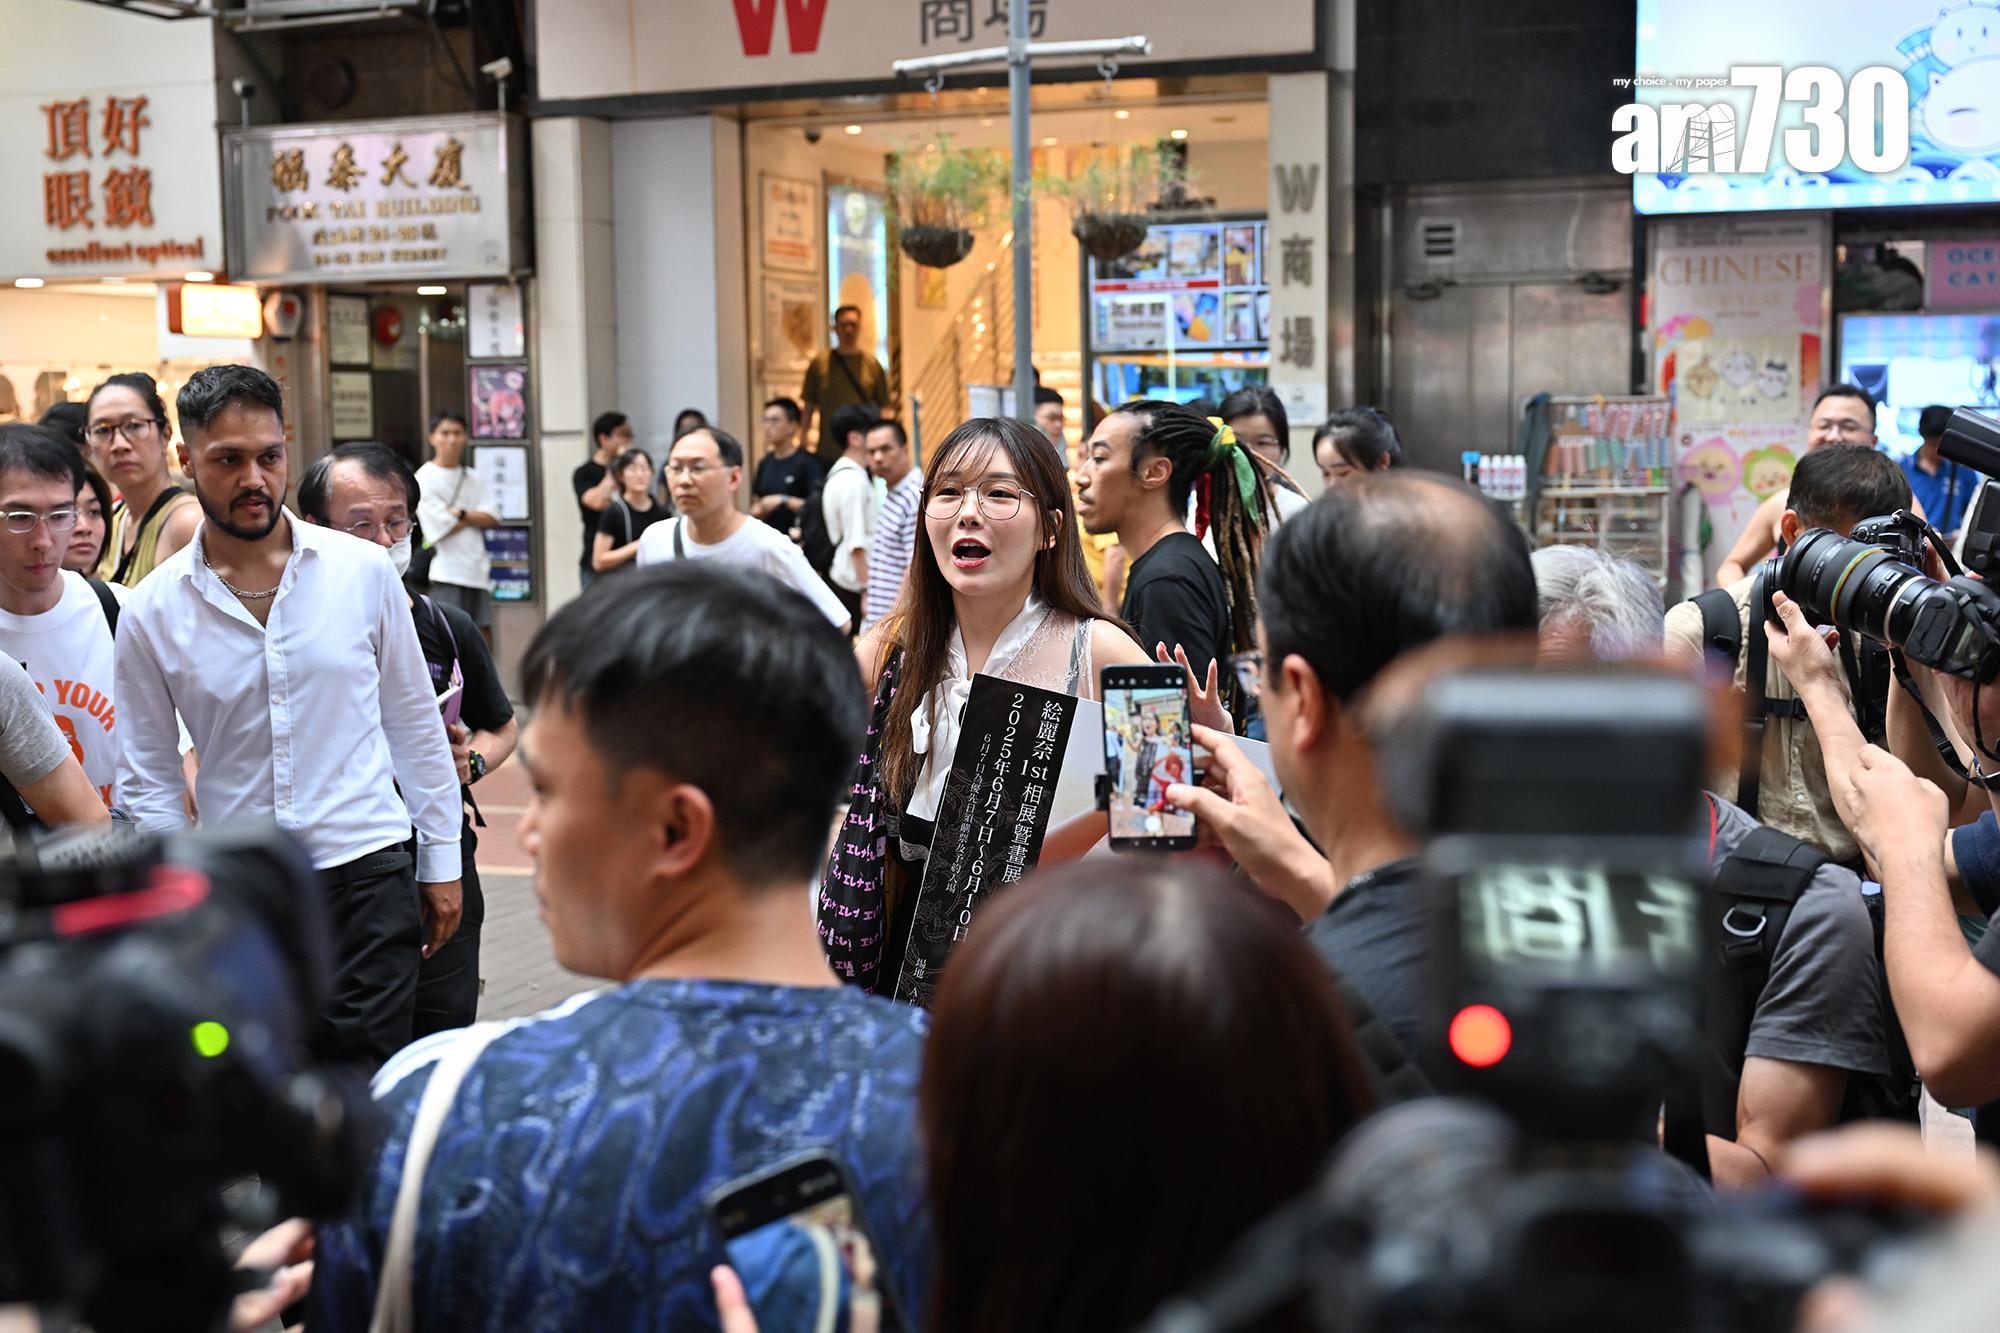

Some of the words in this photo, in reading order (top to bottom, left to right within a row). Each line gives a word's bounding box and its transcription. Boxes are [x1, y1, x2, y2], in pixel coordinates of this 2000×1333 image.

[732, 0, 829, 57] W
[40, 95, 151, 161] 頂好
[44, 163, 155, 231] 眼鏡
[330, 200, 367, 218] TAI
[375, 196, 482, 218] BUILDING
[46, 240, 132, 264] excellent
[135, 235, 205, 267] optical
[1274, 163, 1320, 369] W商場
[1948, 246, 2000, 264] OCE
[1660, 253, 1817, 287] CHINESE
[1948, 271, 2000, 288] CAT
